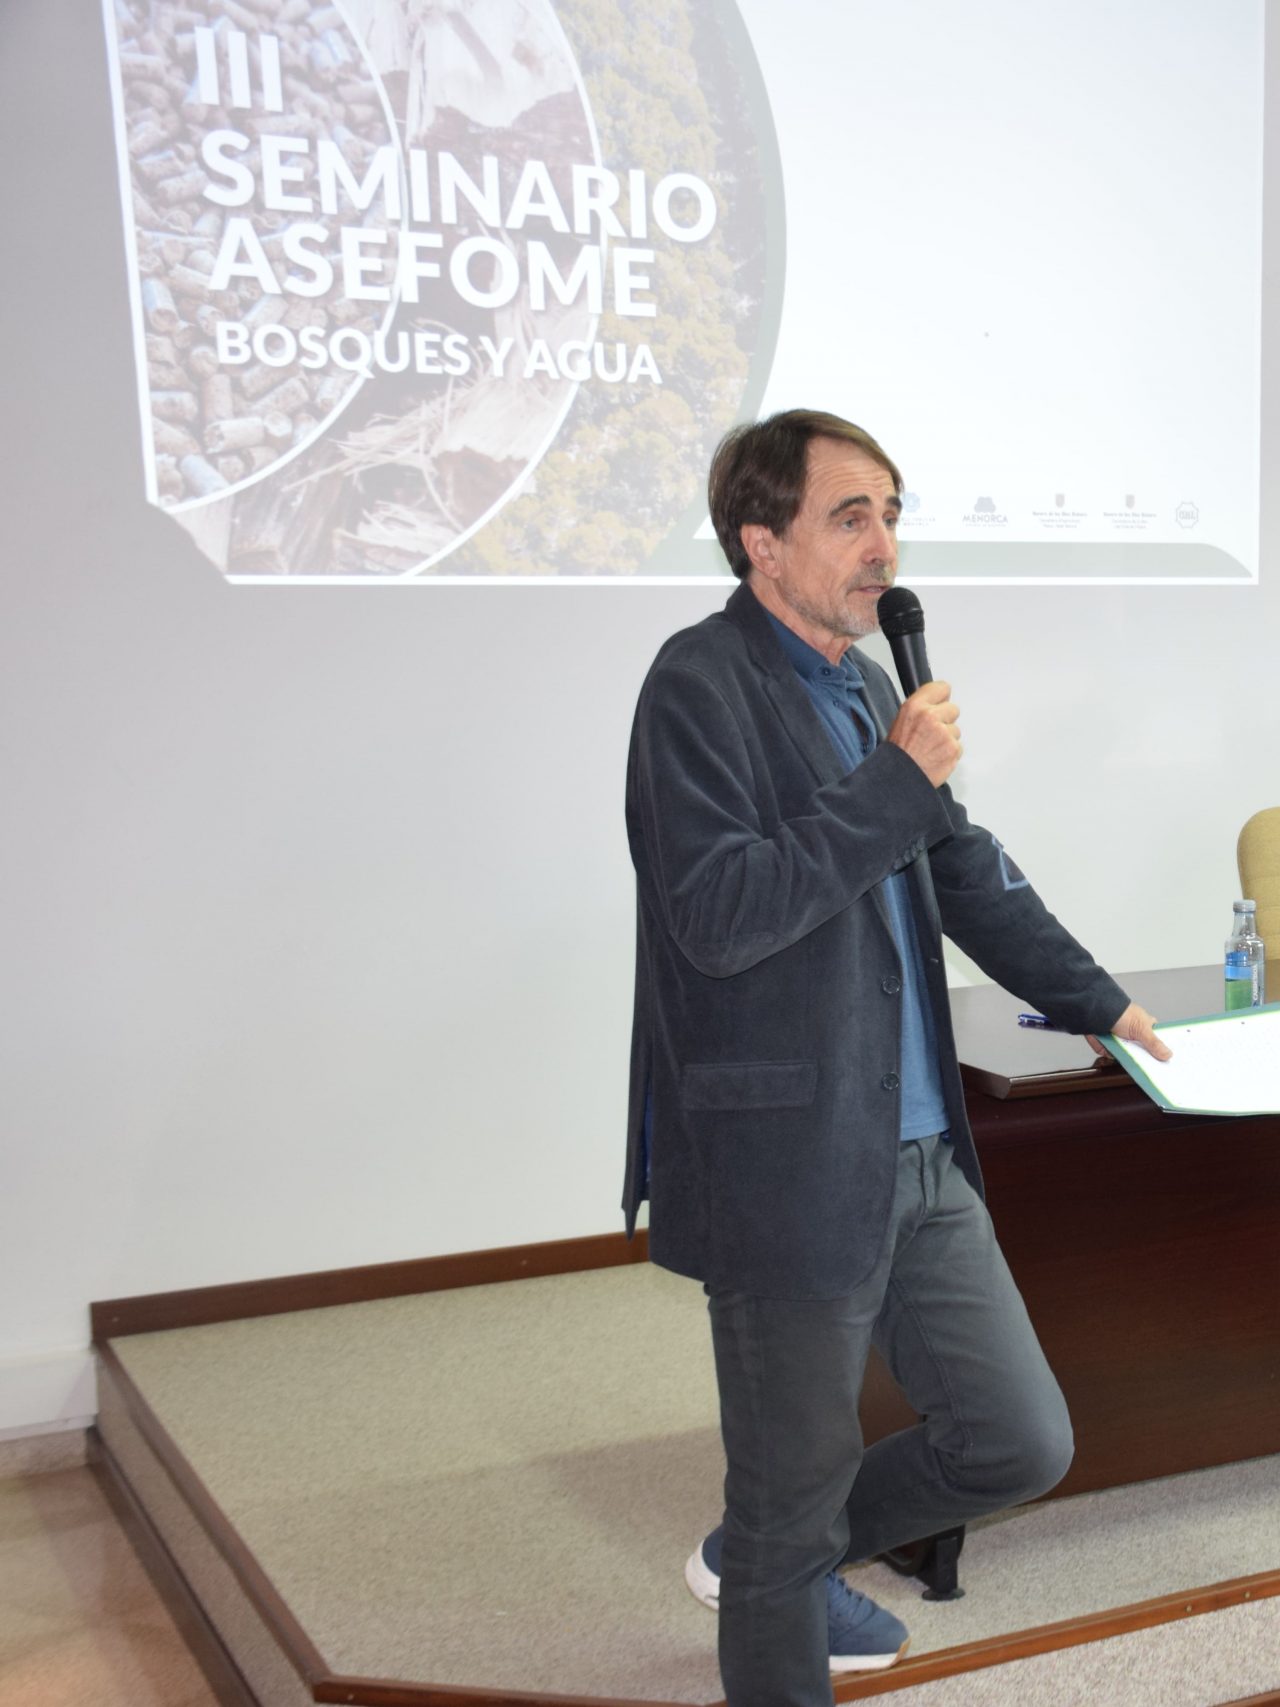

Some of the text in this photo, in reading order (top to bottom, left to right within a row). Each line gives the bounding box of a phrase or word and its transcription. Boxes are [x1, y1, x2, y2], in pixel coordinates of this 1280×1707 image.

[194, 26, 283, 113] III
[201, 129, 718, 243] SEMINARIO
[207, 217, 658, 318] ASEFOME
[215, 321, 663, 384] BOSQUES Y AGUA
[962, 514, 1009, 524] MENORCA
